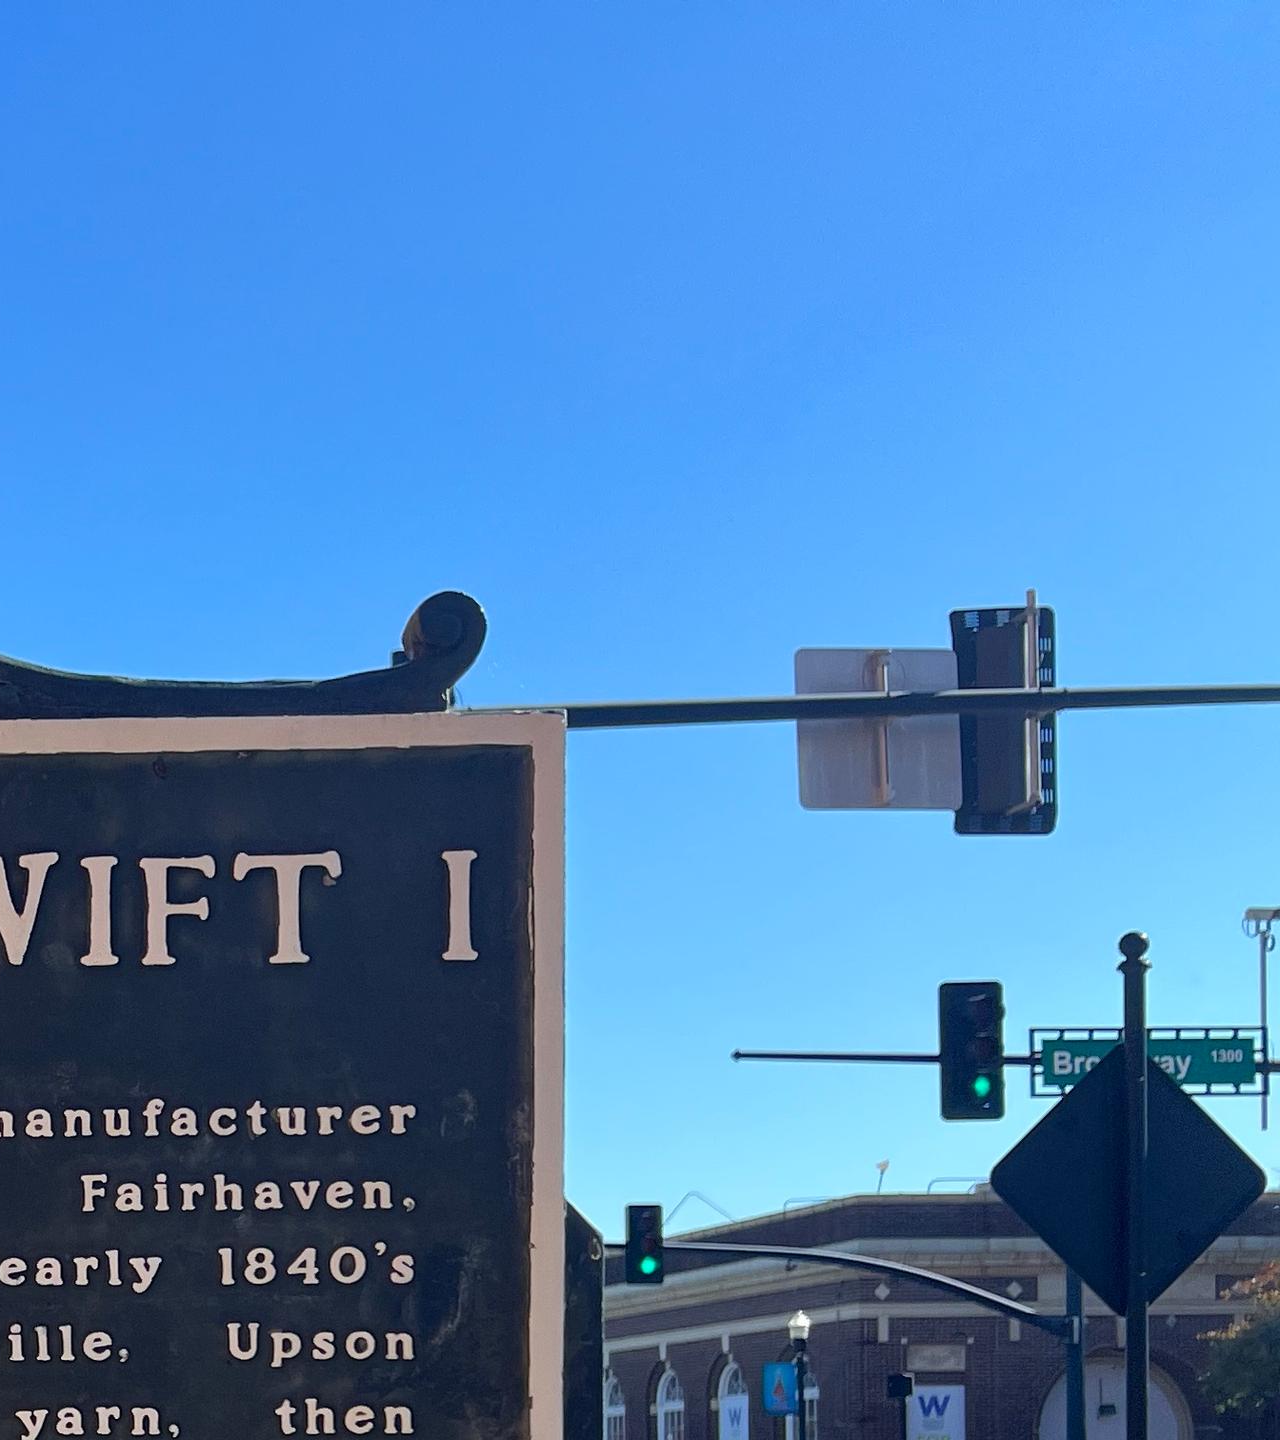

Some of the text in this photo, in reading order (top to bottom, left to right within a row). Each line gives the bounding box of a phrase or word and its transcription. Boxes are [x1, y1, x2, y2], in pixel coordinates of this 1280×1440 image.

[441, 850, 479, 961] I
[1209, 1048, 1244, 1064] 1300
[80, 1173, 415, 1212] Fairhaven,
[218, 1241, 414, 1286] 1840's
[226, 1322, 415, 1368] Upson
[274, 1398, 414, 1435] then
[918, 1395, 951, 1417] W
